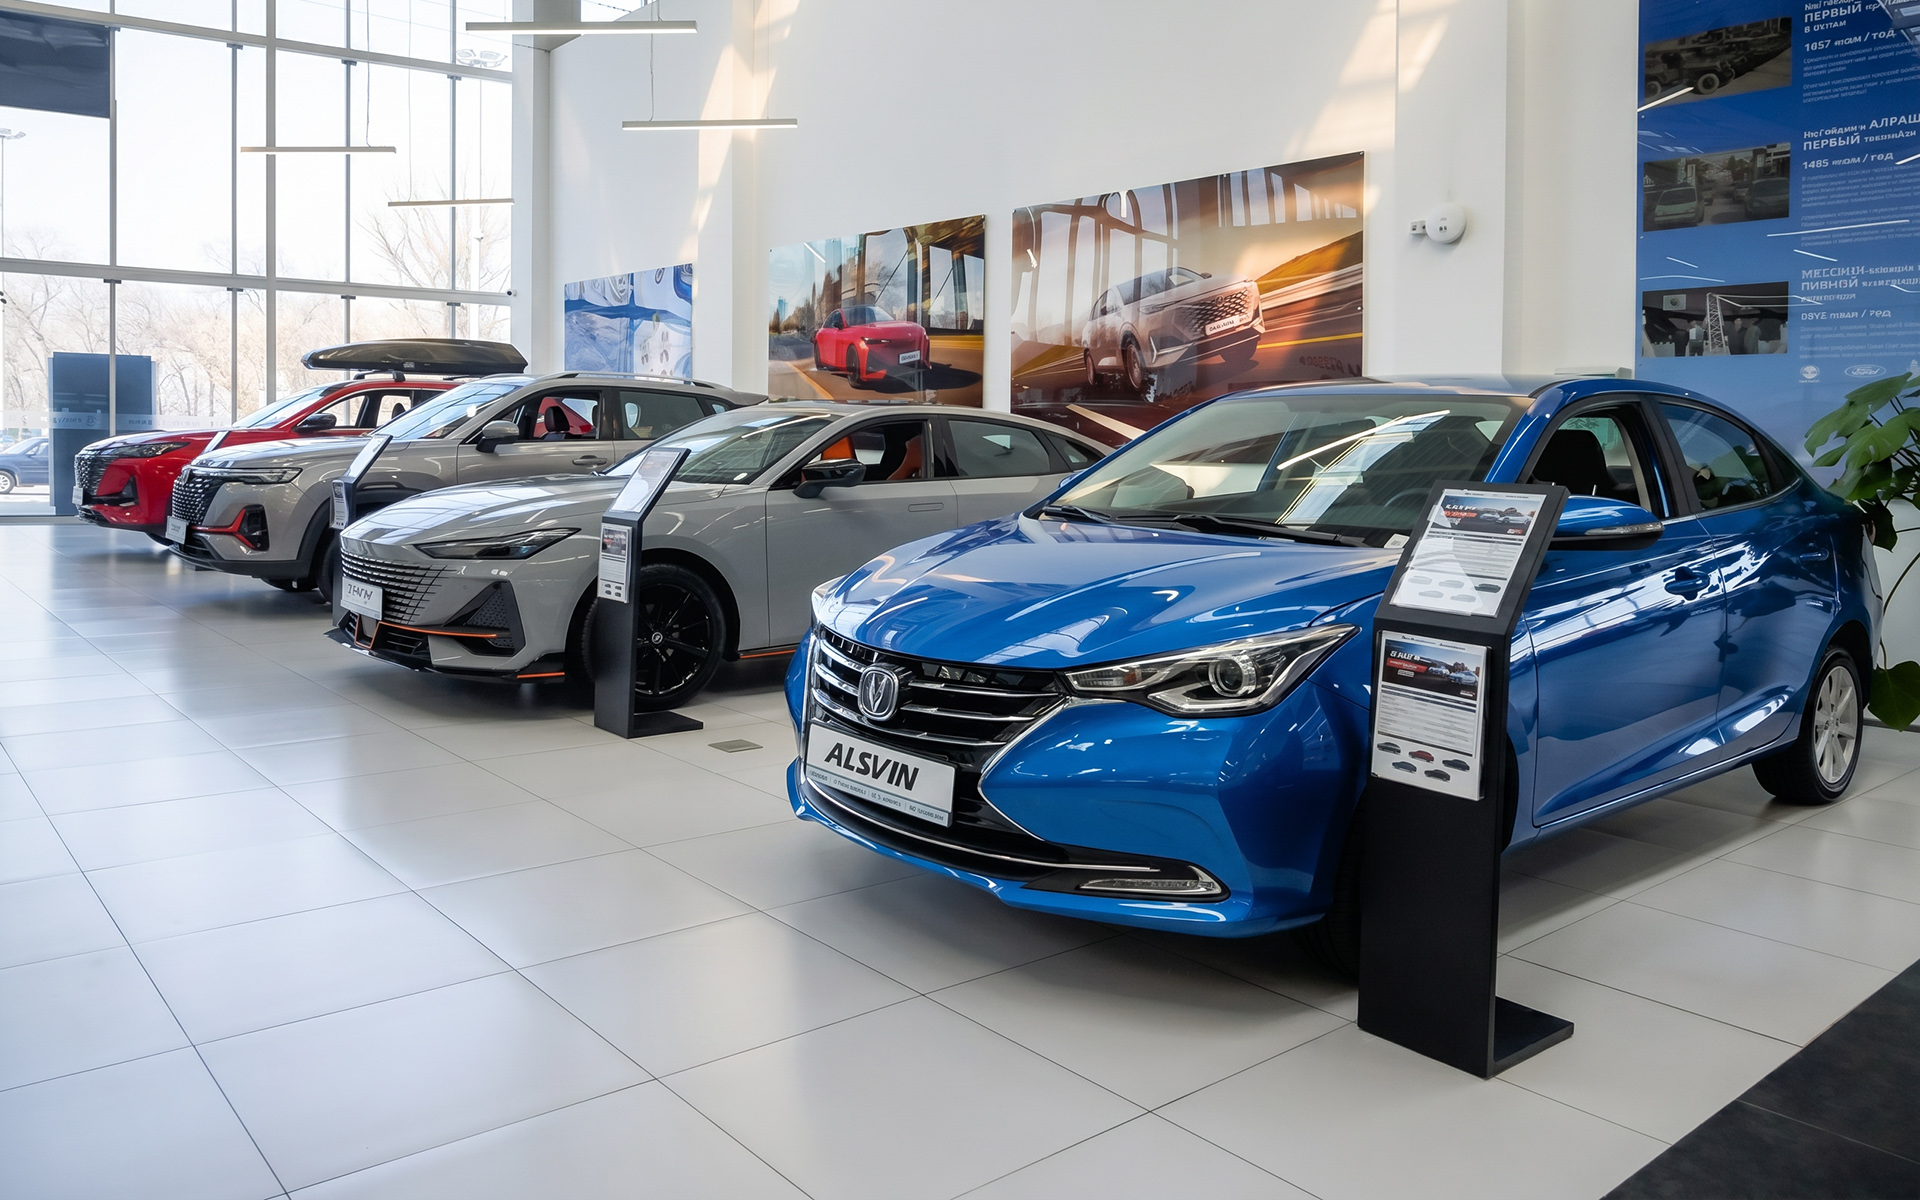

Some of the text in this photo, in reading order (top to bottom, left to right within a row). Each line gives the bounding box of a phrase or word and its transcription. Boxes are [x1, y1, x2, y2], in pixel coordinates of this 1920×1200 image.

[1804, 1, 1862, 23] ПЕРВЫЙ
[1802, 159, 1829, 170] 1485
[824, 742, 919, 791] ALSVIN
